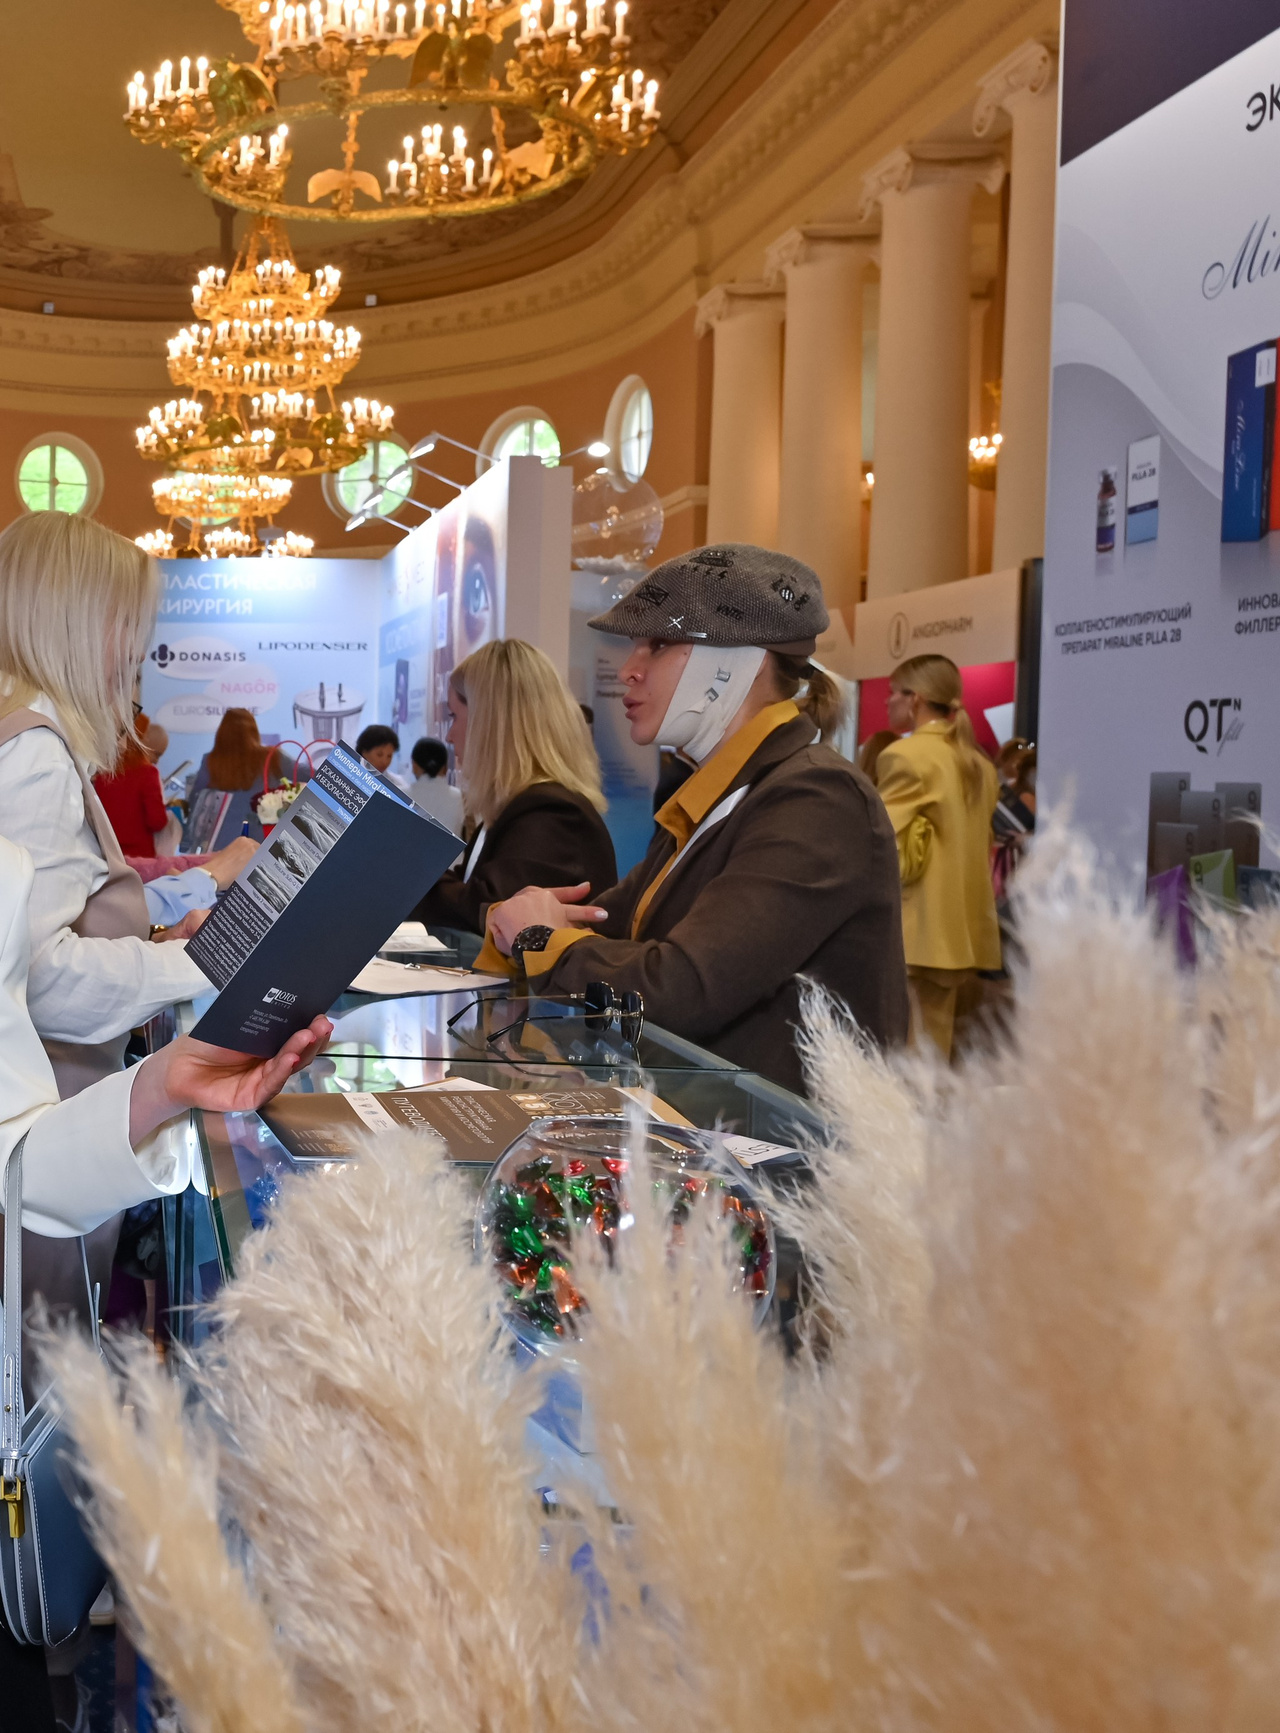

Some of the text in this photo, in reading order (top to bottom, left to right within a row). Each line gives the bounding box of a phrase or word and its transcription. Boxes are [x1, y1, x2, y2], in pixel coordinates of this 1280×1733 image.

[1238, 593, 1280, 612] ИННОВ
[259, 641, 368, 651] LIPODENSER
[1145, 630, 1168, 645] PLLA
[179, 652, 246, 661] DONASIS
[332, 747, 363, 777] Филлеры
[320, 764, 355, 796] ДОКАЗАННЫЕ
[319, 776, 360, 814] БЕЗОПАСНОСТЬ
[274, 990, 297, 1005] LOTOS
